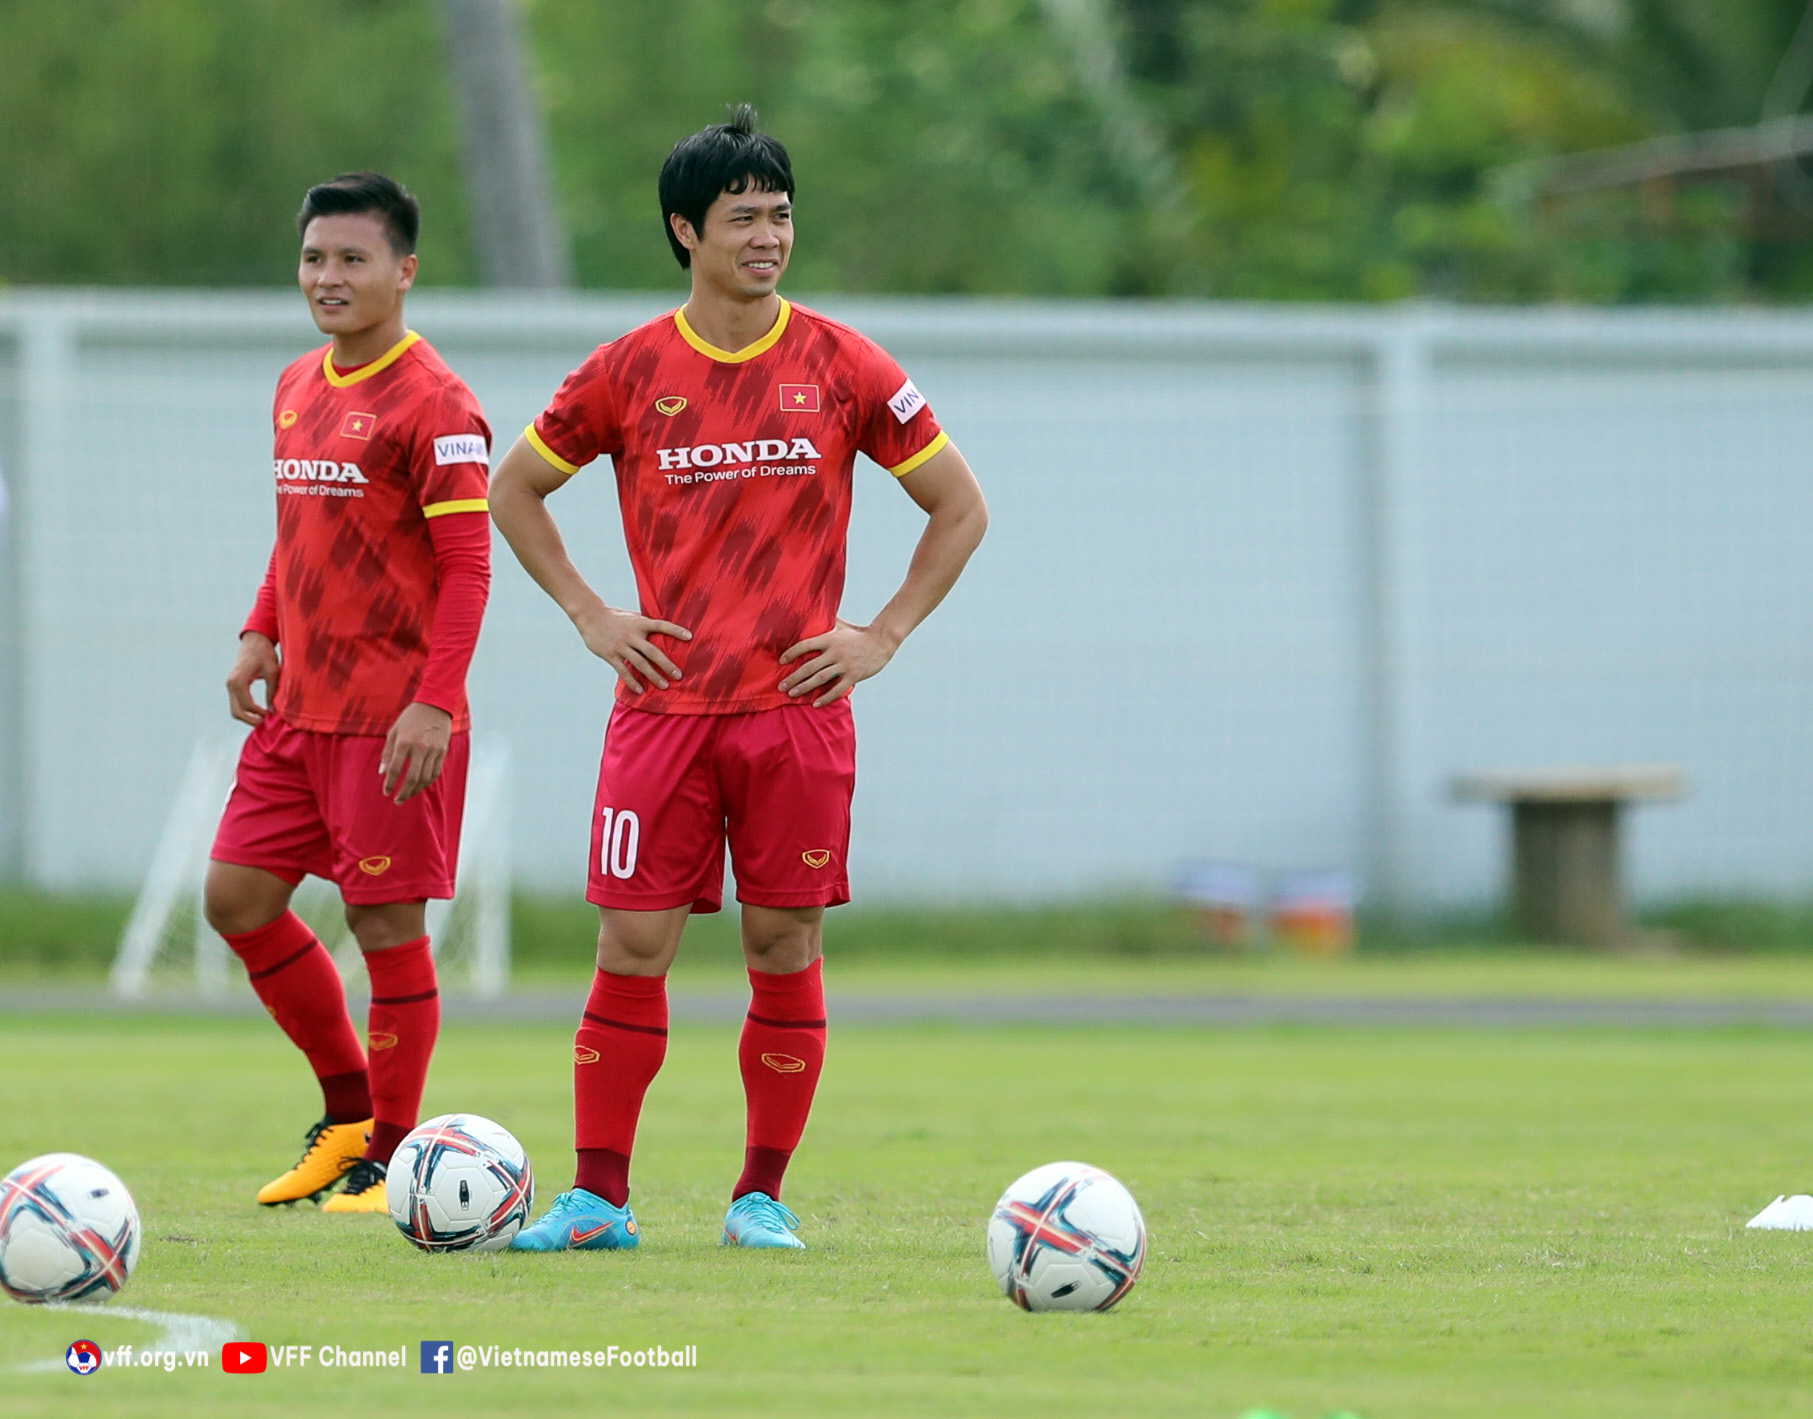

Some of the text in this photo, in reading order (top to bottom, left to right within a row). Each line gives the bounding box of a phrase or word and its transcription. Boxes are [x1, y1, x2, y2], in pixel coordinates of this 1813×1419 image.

[656, 438, 822, 470] HONDA
[665, 465, 816, 485] The Power of Dreams
[283, 484, 308, 495] Power
[309, 484, 319, 495] of
[319, 485, 364, 498] Dreams
[601, 807, 639, 879] 10
